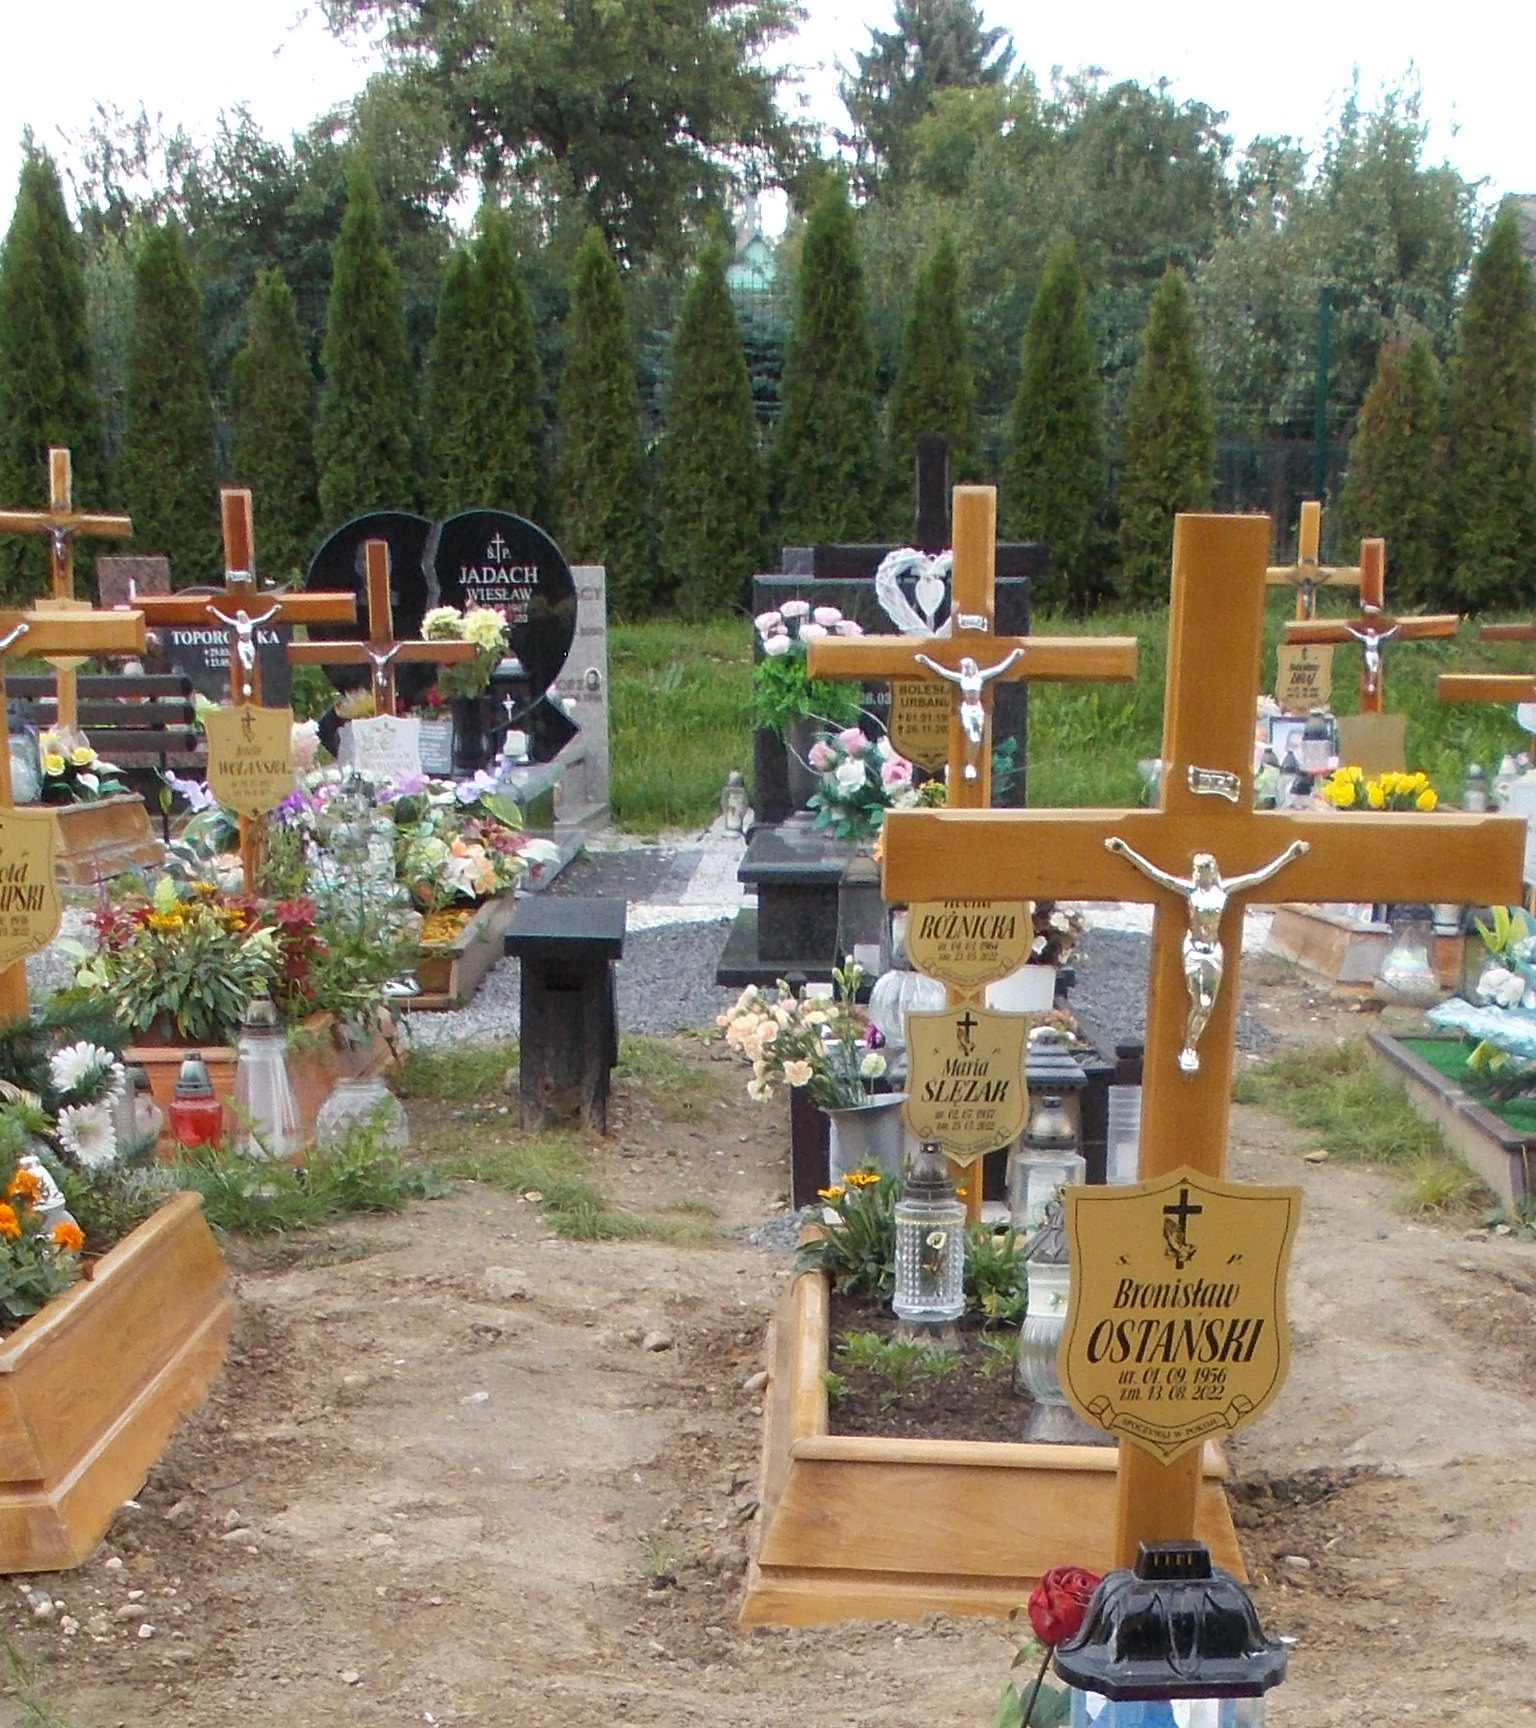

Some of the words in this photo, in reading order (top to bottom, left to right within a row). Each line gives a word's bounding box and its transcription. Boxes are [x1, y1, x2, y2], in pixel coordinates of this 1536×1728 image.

[458, 567, 540, 585] JADACH
[466, 586, 535, 602] WIESŁAW
[942, 1058, 990, 1077] Maria
[921, 1076, 1011, 1108] ŚLĘZAK
[1113, 1277, 1242, 1309] Bronisław
[1086, 1311, 1265, 1364] OSTAŃSKI
[1192, 1367, 1228, 1384] 1956
[1191, 1385, 1226, 1401] 2022
